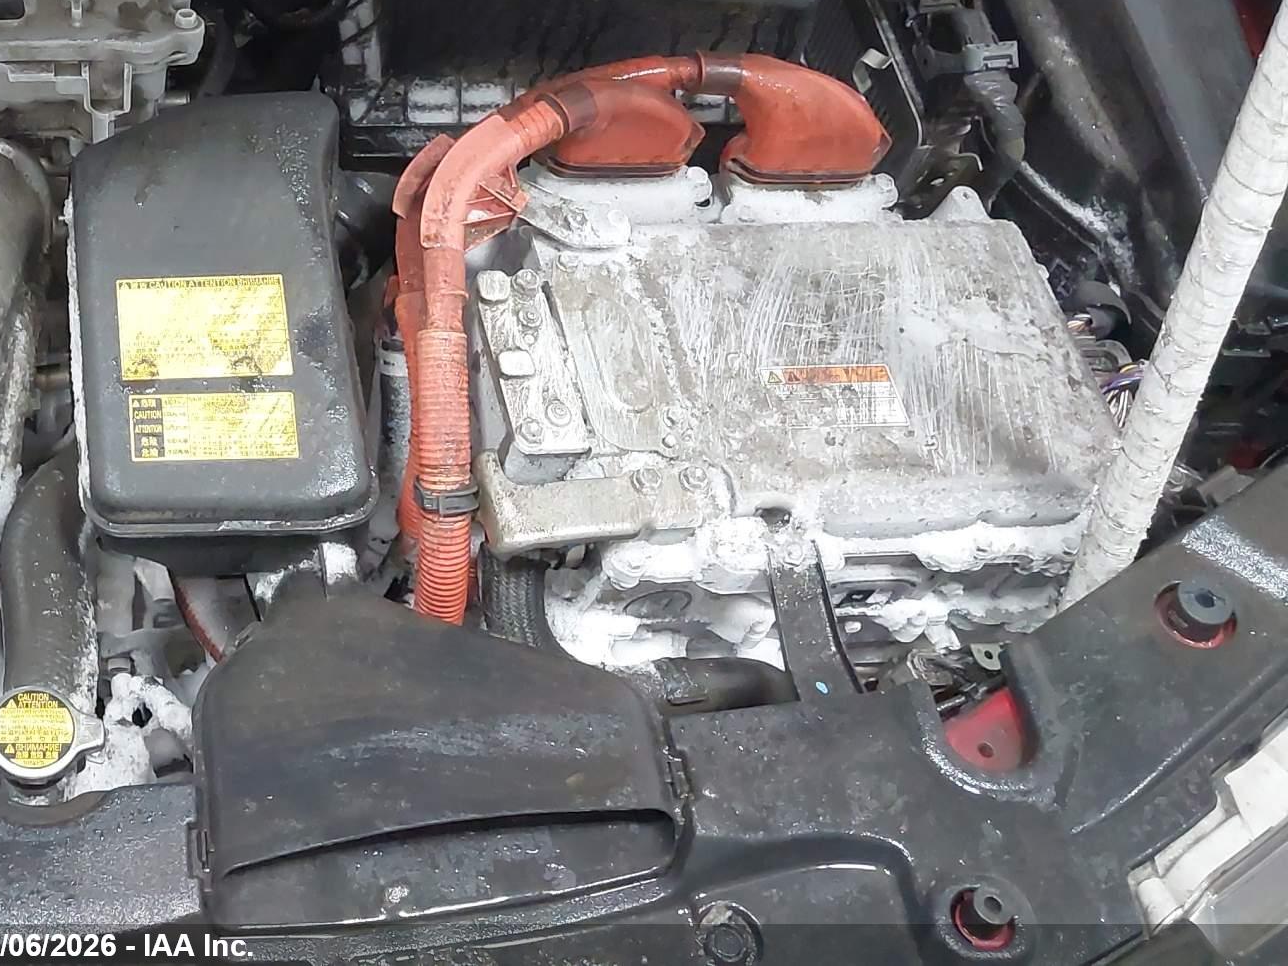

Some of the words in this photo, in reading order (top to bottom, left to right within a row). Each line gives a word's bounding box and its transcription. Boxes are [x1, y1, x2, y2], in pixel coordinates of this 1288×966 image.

[134, 410, 162, 419] CAUTION
[17, 693, 50, 701] CAUTION
[17, 701, 59, 709] ATTENTION
